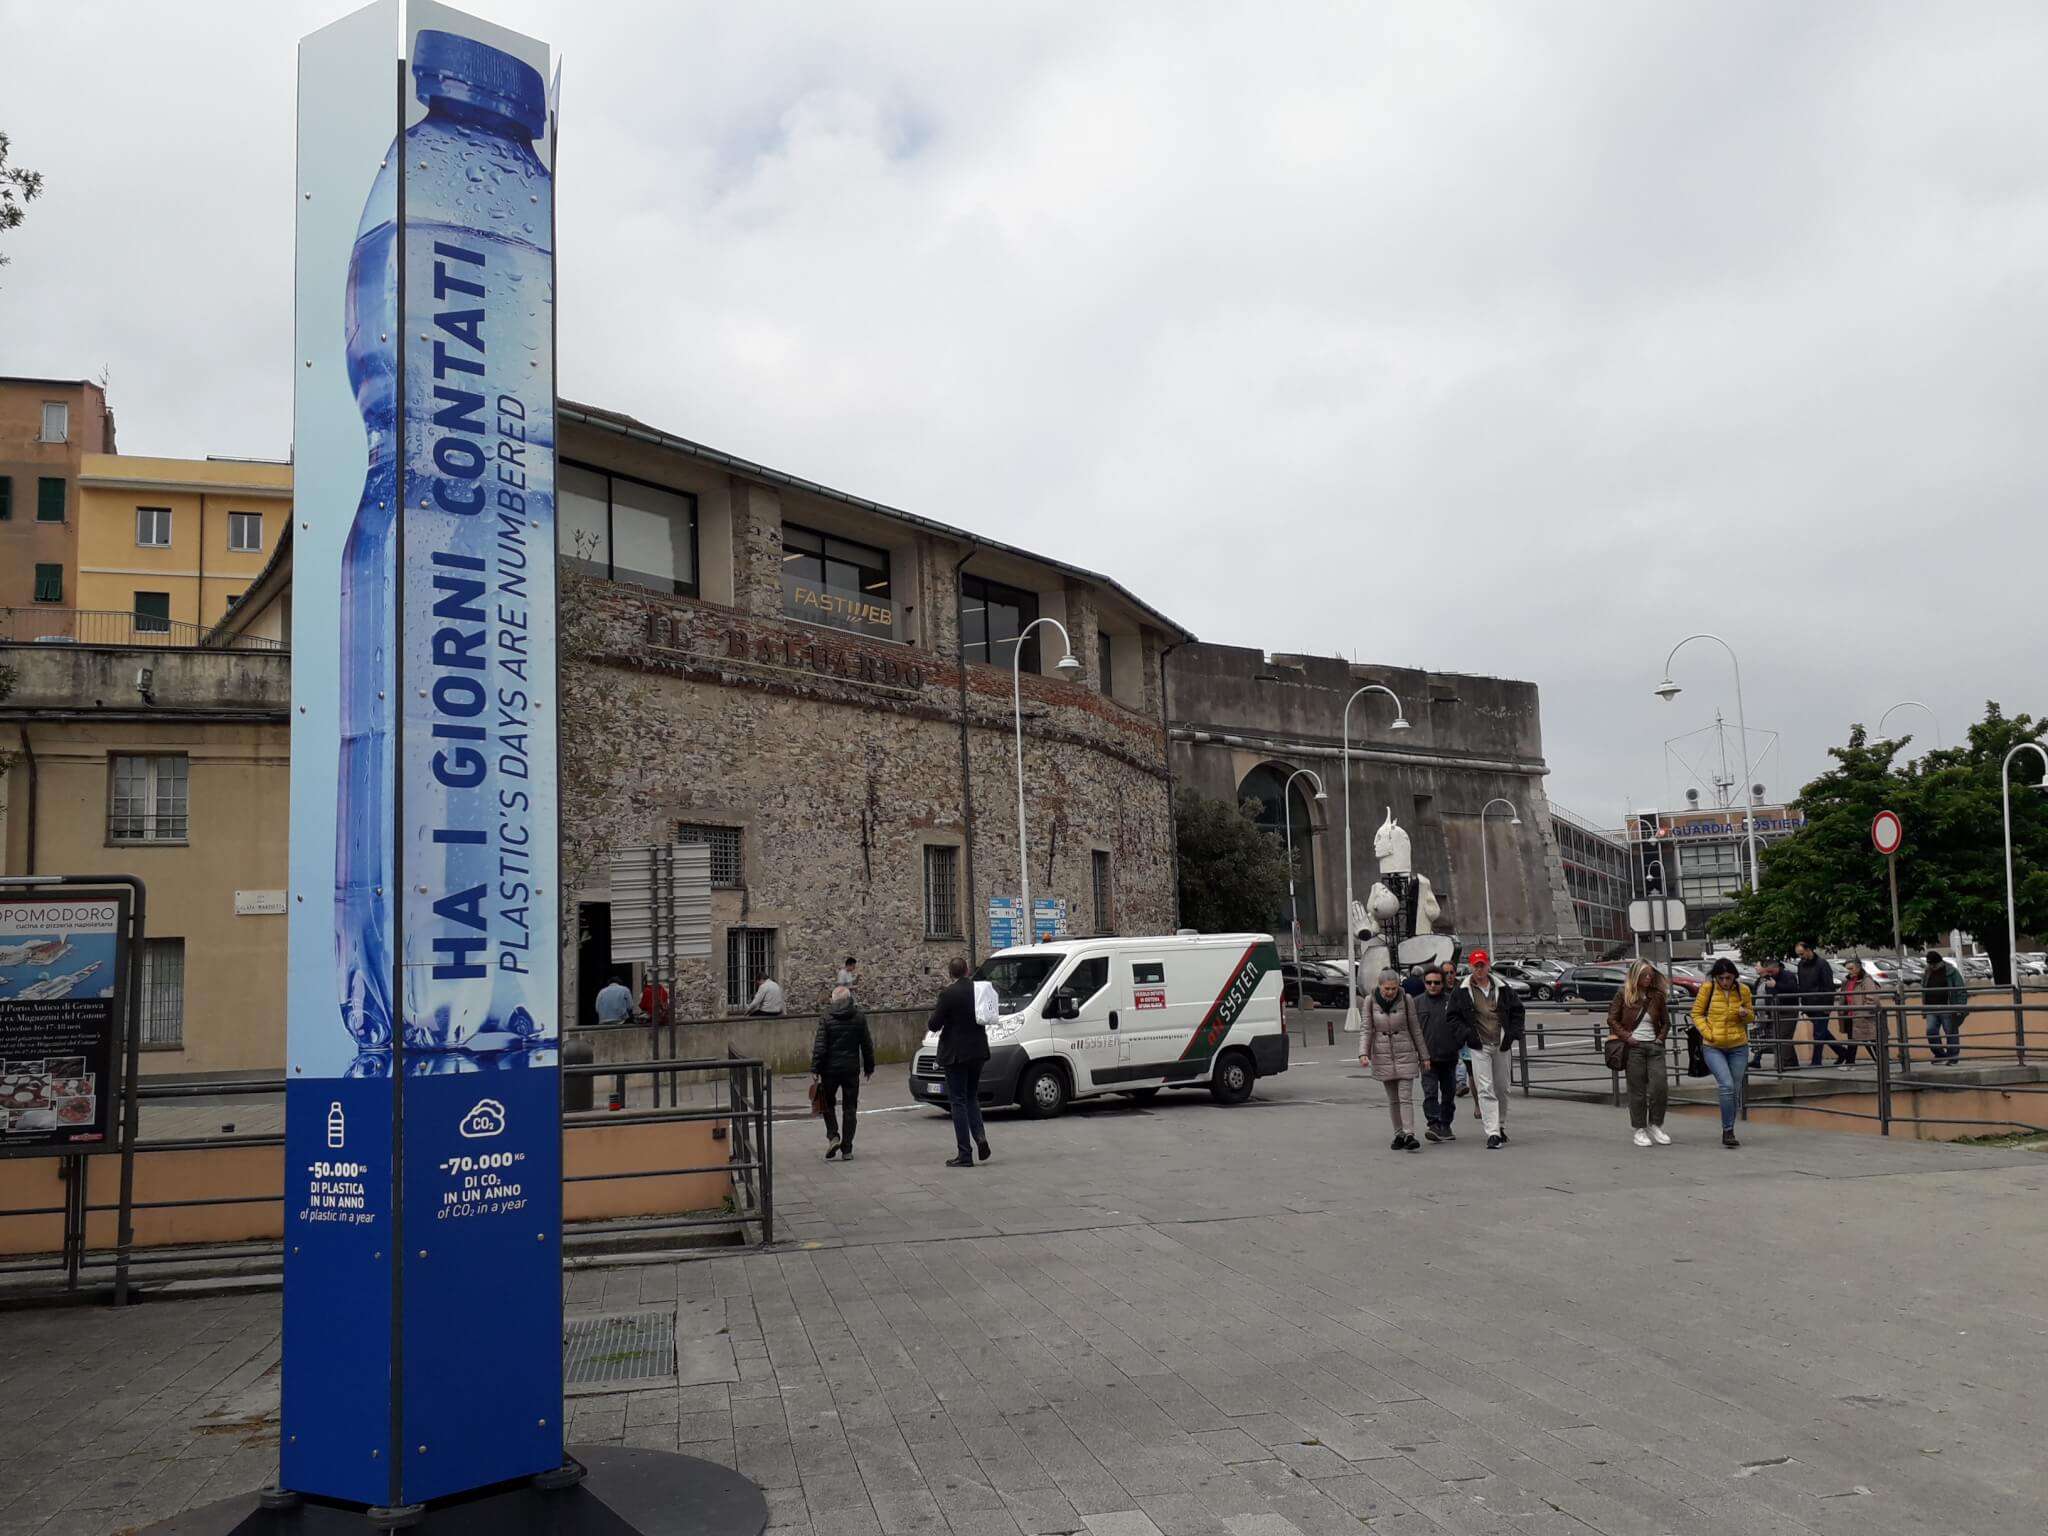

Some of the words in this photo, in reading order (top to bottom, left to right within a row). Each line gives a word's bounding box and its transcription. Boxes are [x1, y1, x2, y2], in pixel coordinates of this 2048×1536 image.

[432, 240, 486, 515] CONTATI
[497, 394, 527, 598] NUMBERED
[498, 604, 528, 681] ARE
[432, 552, 487, 788] GIORNI
[499, 688, 528, 779] DAYS
[432, 829, 487, 844] I
[1672, 823, 1733, 836] GUARDIA
[500, 789, 529, 974] PLASTIC'S
[0, 907, 115, 923] POMODORO
[432, 883, 487, 980] HA
[1220, 961, 1259, 1022] SYSTEM
[73, 1002, 104, 1010] Genova
[310, 1182, 319, 1194] DI
[322, 1182, 364, 1195] PLASTICA
[465, 1176, 478, 1188] DI
[310, 1196, 320, 1207] IN
[323, 1196, 336, 1208] UN
[338, 1196, 364, 1209] ANNO
[444, 1192, 457, 1205] IN
[462, 1190, 480, 1202] UN
[485, 1184, 521, 1199] ANNO
[300, 1210, 308, 1221] of
[309, 1210, 337, 1223] plastic
[339, 1211, 347, 1222] in
[349, 1214, 354, 1222] a
[355, 1213, 375, 1226] year
[437, 1205, 451, 1220] of
[477, 1202, 488, 1215] in
[491, 1203, 498, 1213] a
[499, 1198, 527, 1214] year
